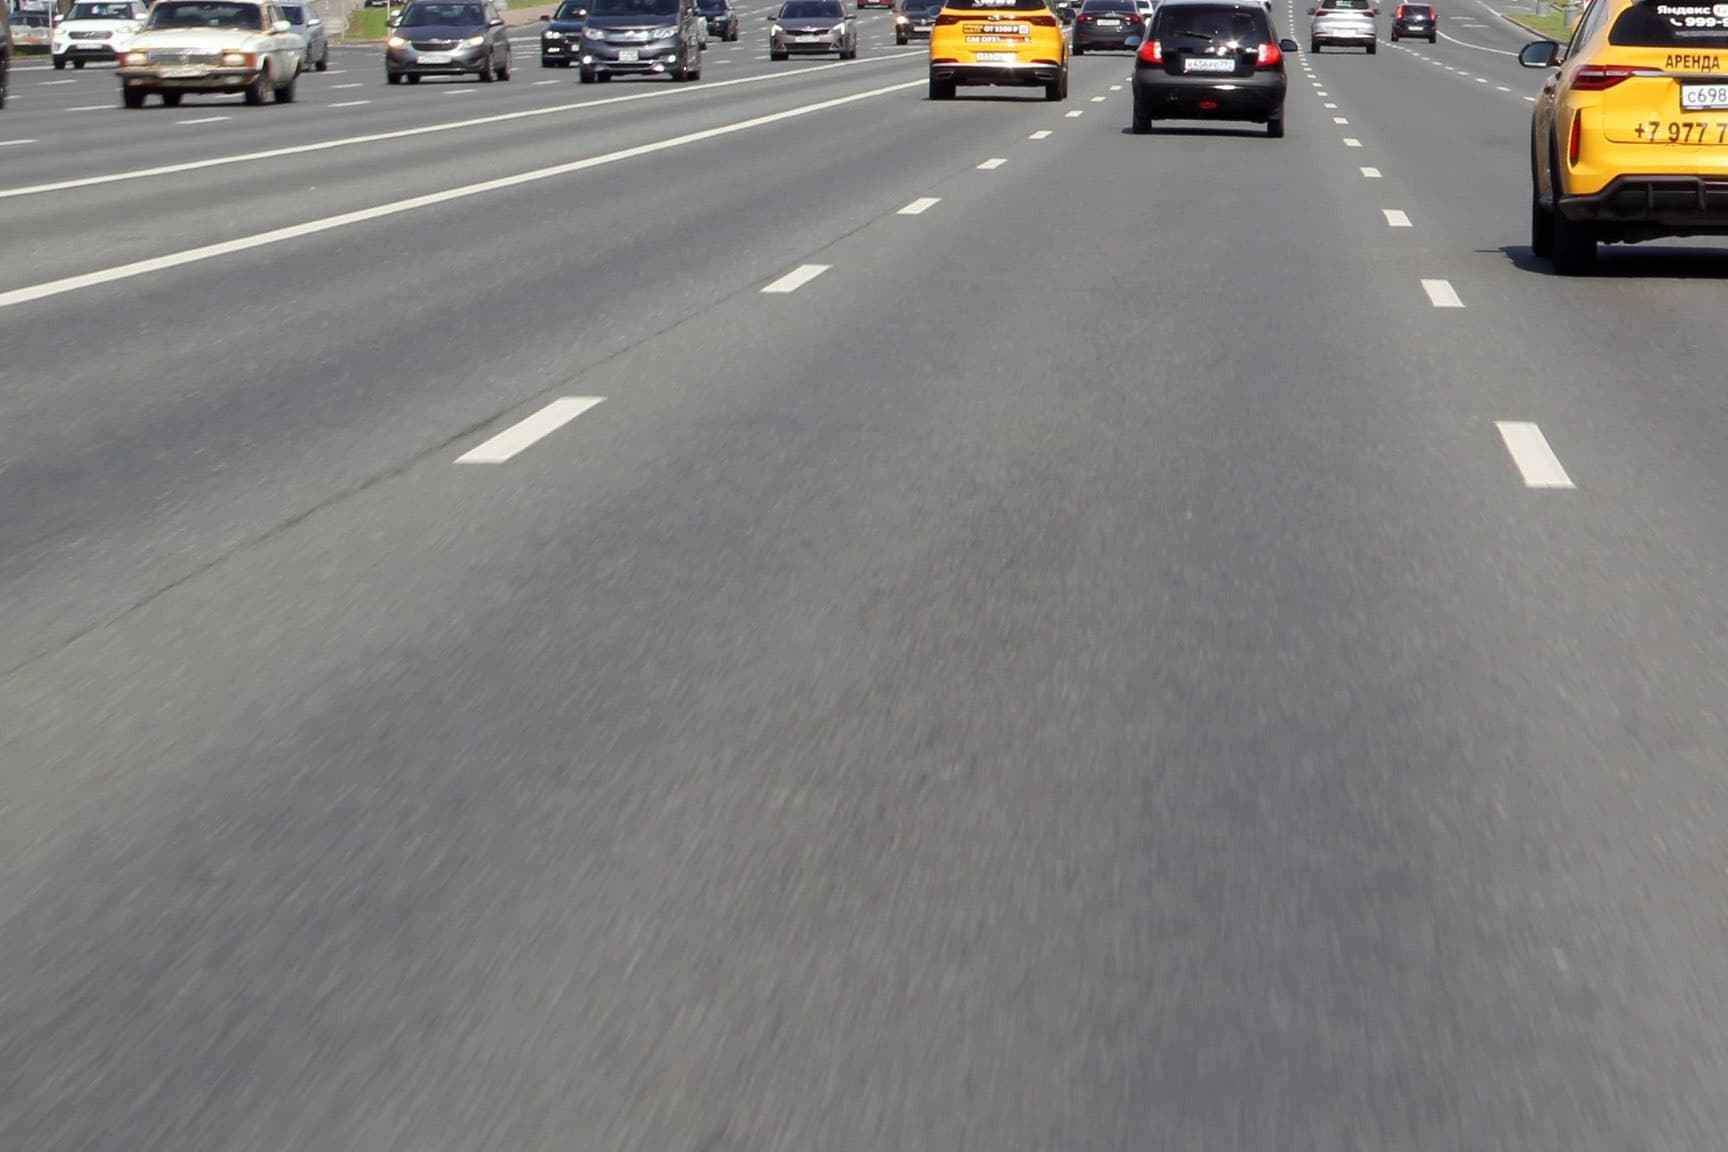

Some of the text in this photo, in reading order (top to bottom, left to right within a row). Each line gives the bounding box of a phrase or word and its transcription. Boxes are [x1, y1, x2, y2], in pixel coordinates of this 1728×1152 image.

[1657, 4, 1711, 16] Яндекс
[1665, 54, 1720, 72] АРЕНДА
[1634, 121, 1660, 143] +7
[1668, 122, 1708, 143] 977
